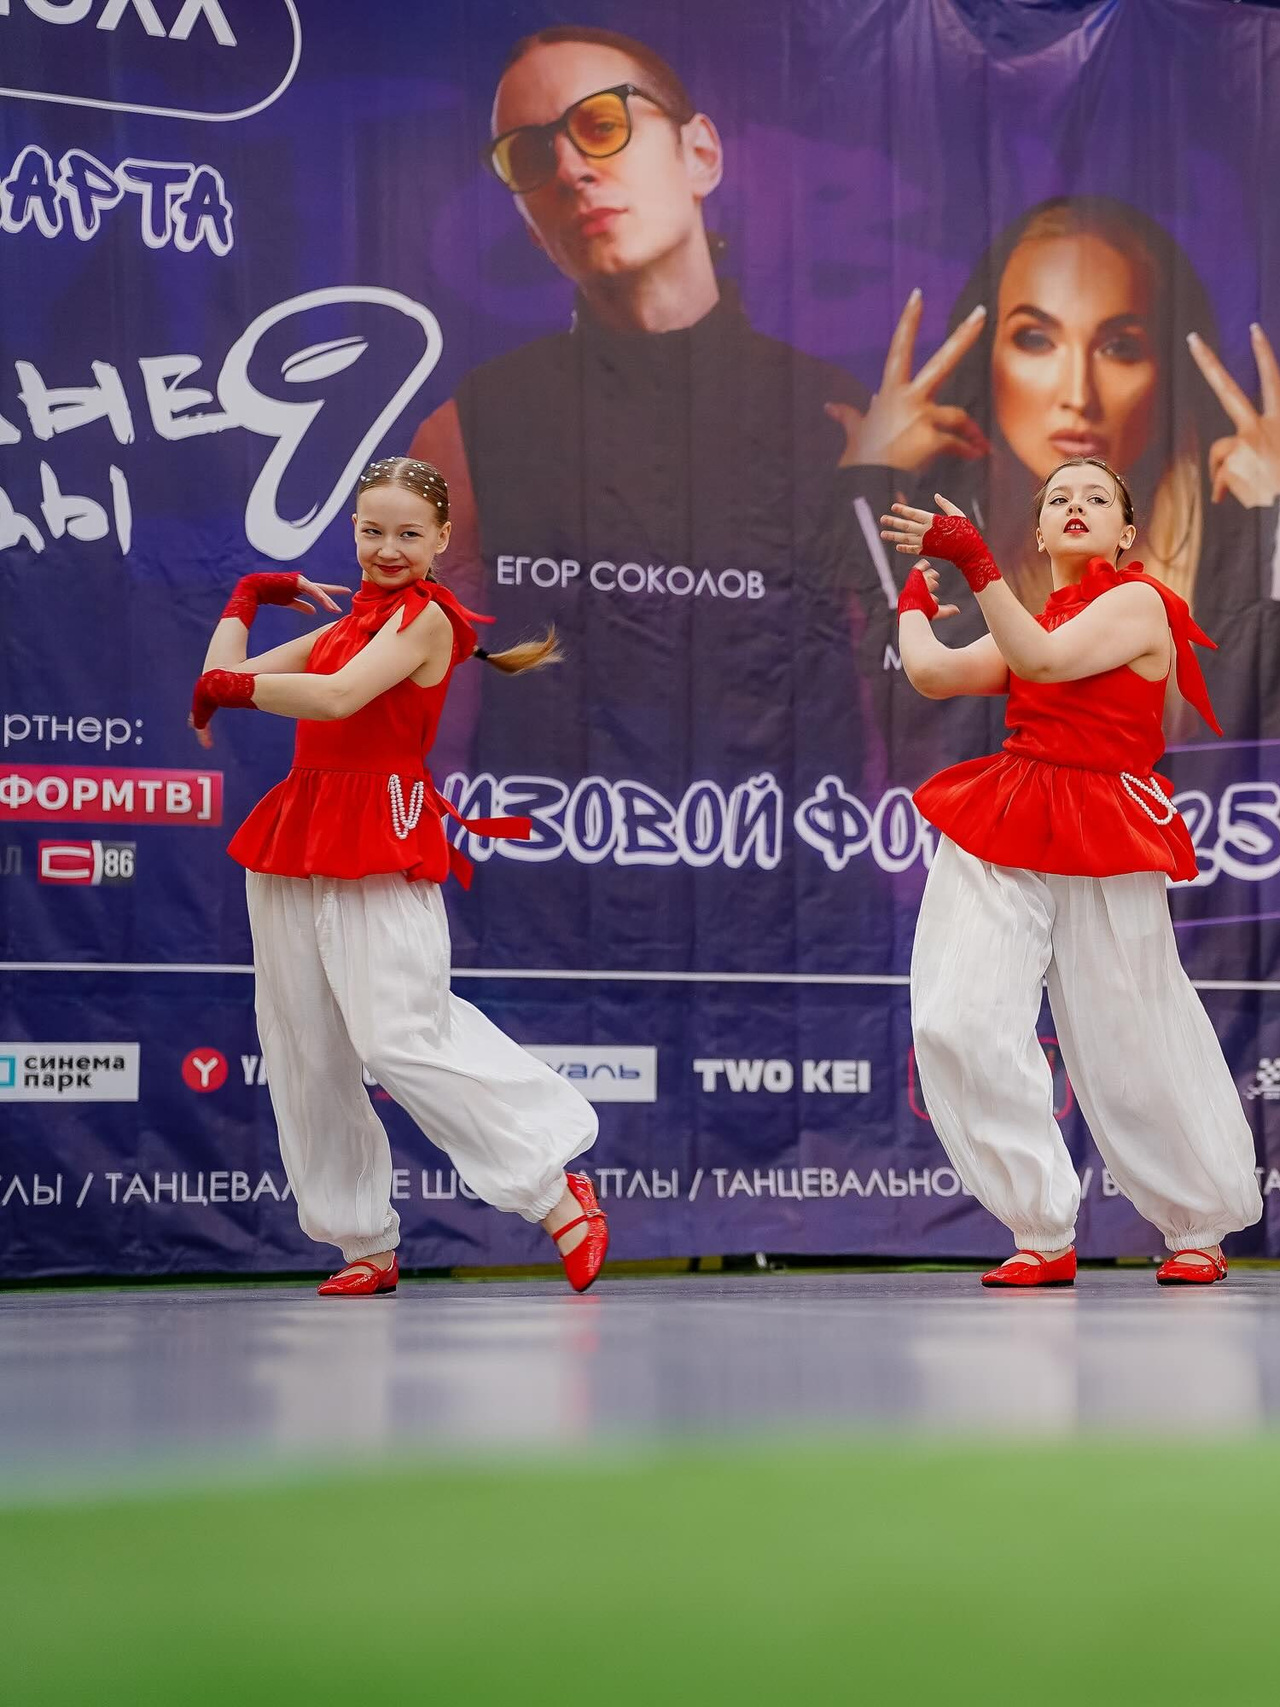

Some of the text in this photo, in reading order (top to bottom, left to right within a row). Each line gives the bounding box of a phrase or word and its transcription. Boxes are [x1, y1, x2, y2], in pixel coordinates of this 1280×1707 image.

[0, 354, 227, 444] ЫЕ
[496, 555, 765, 599] ЕГОР СОКОЛОВ
[23, 1054, 125, 1071] синема
[693, 1059, 871, 1094] TWO KEI
[24, 1072, 92, 1093] парк
[0, 1172, 62, 1206] ЛЫ
